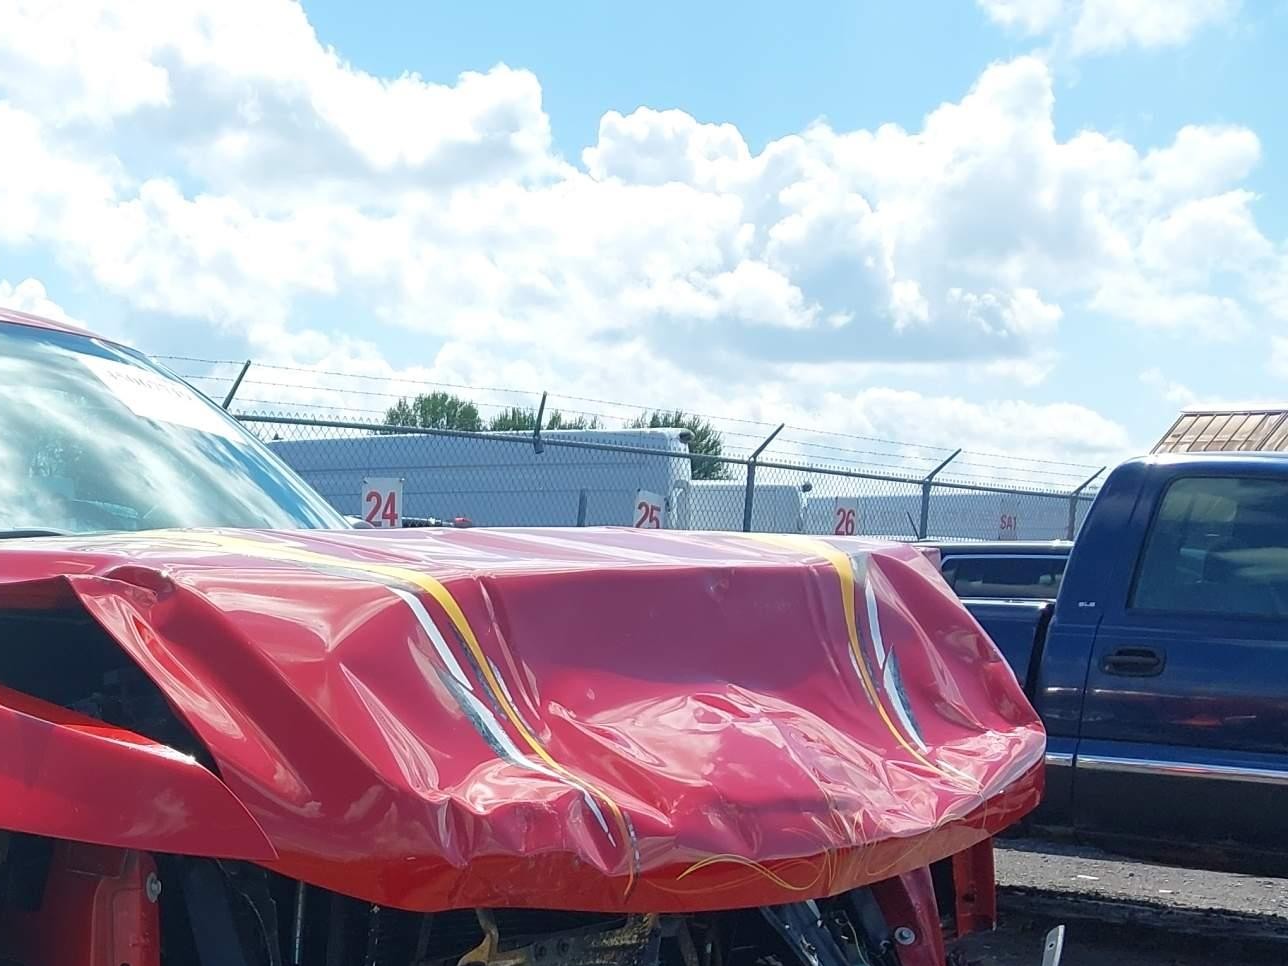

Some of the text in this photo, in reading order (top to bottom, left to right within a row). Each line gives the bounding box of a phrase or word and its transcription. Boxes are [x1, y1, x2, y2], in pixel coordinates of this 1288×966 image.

[365, 490, 399, 528] 24
[635, 501, 662, 529] 25
[835, 507, 856, 536] 26
